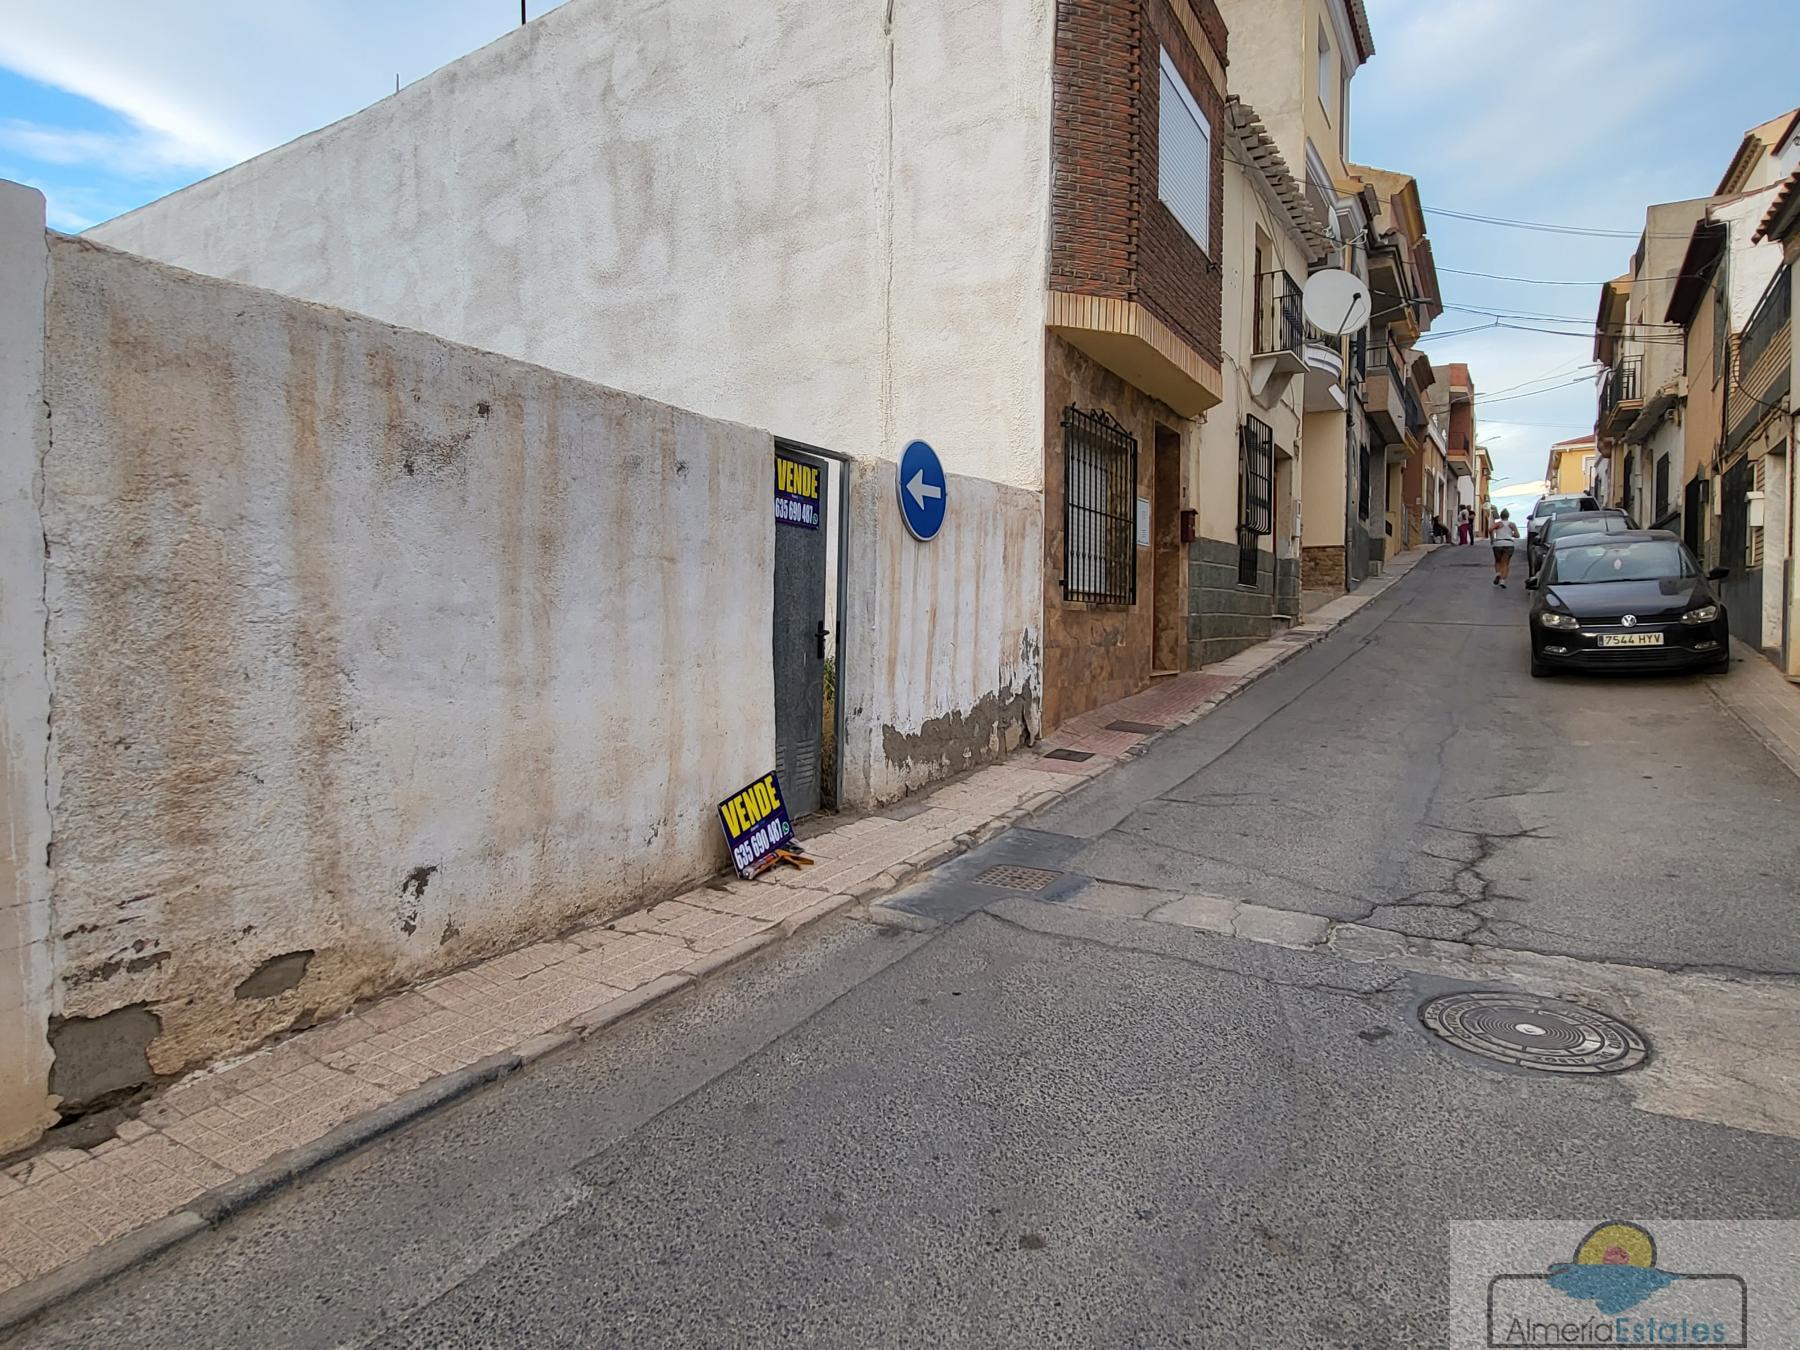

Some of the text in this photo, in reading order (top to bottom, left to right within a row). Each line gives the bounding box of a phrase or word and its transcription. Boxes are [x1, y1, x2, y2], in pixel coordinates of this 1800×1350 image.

[777, 458, 818, 499] VENDE
[775, 498, 813, 524] 635 690 487
[1605, 634, 1661, 645] 7544 HYV
[721, 775, 781, 839] VENDE
[734, 840, 754, 870] 635
[750, 828, 770, 858] 690
[767, 817, 783, 845] 487
